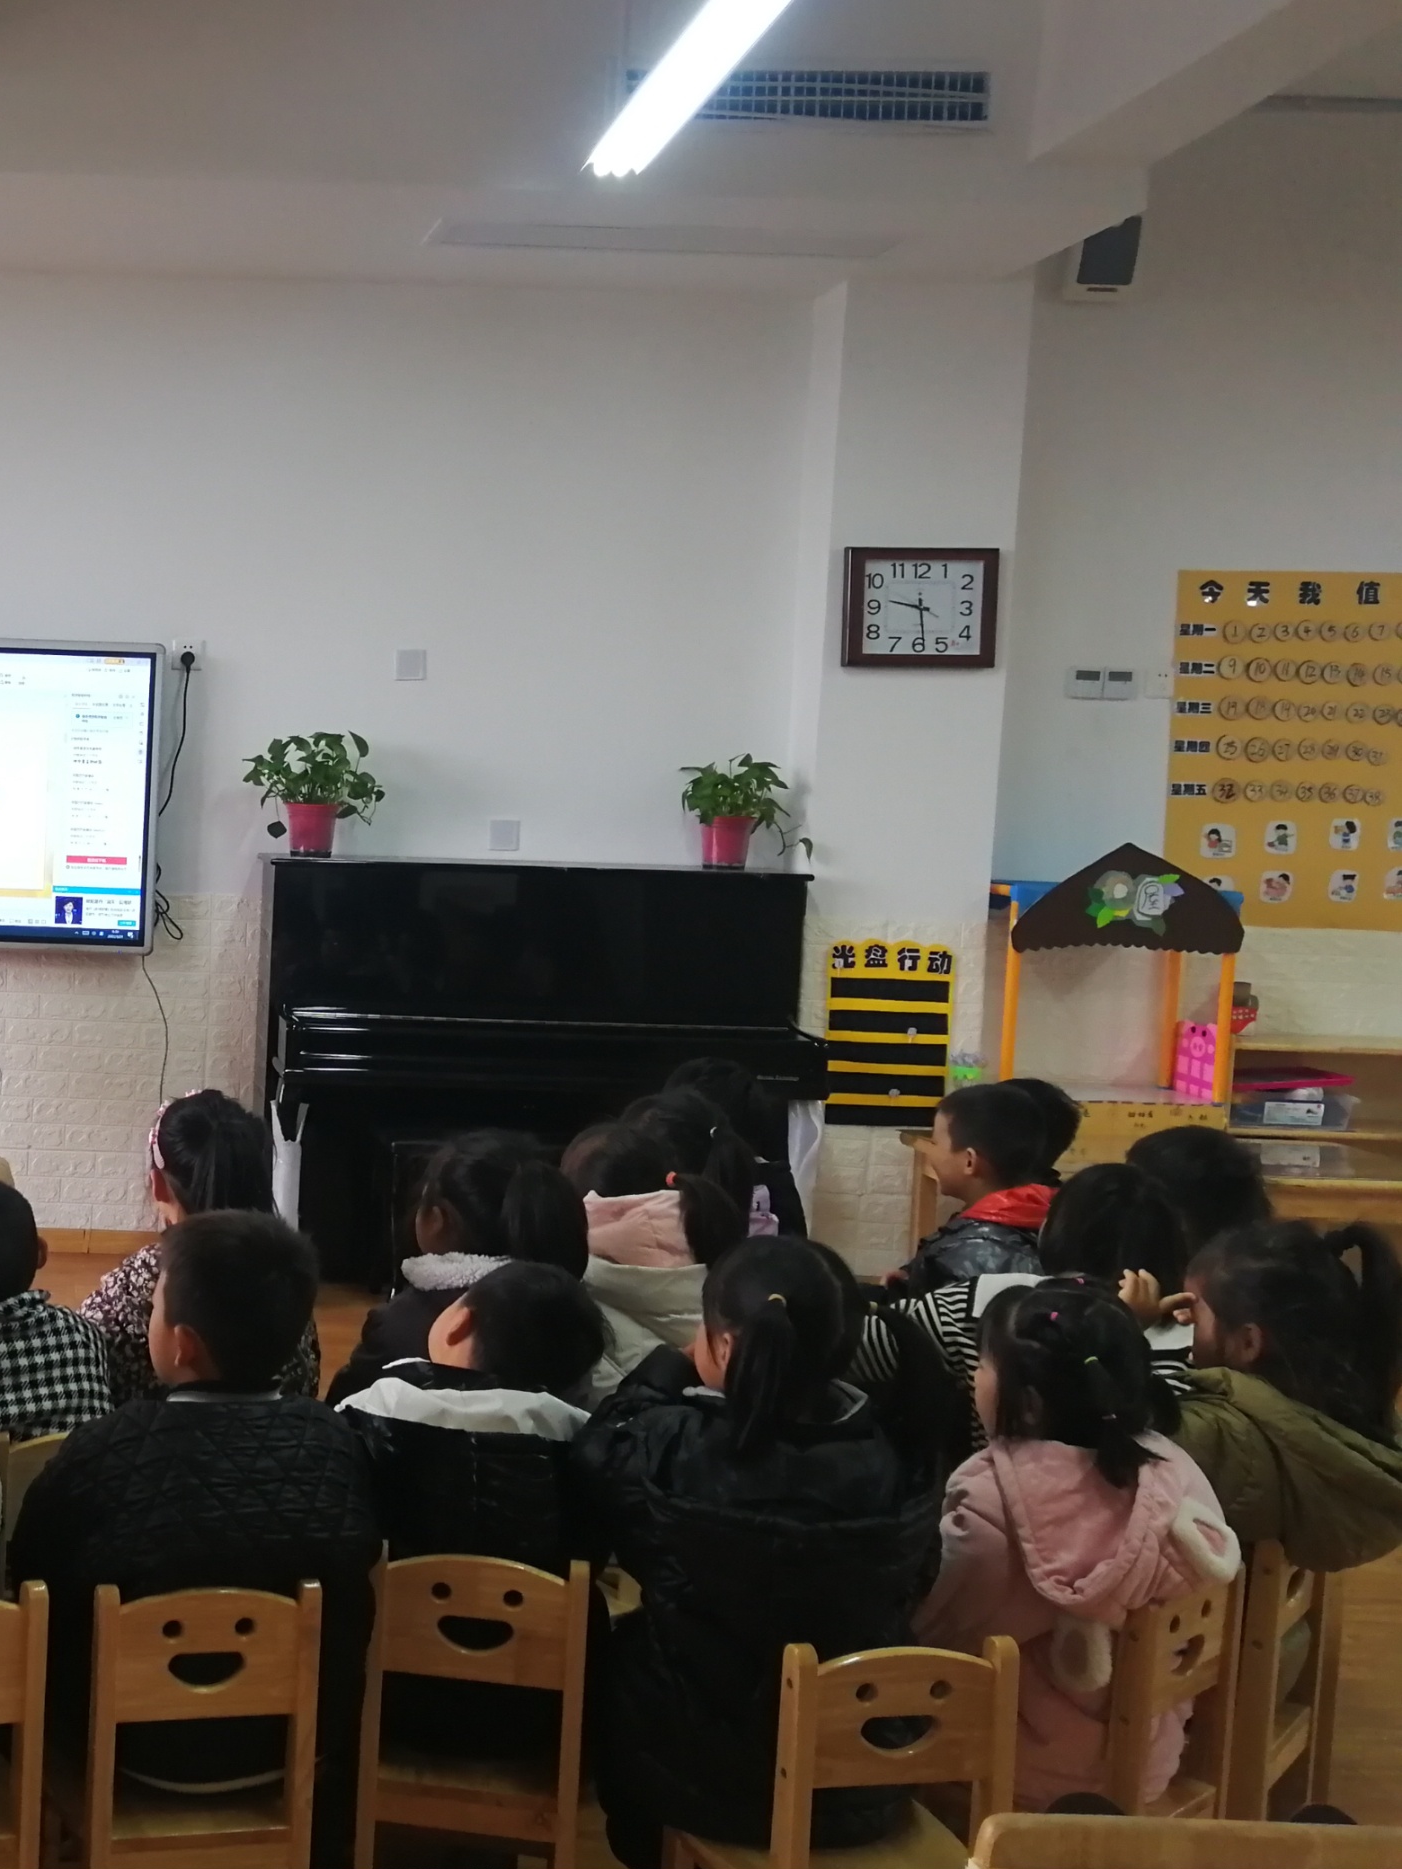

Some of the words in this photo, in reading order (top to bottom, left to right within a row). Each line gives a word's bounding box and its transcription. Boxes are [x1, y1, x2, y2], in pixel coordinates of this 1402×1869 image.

[890, 562, 905, 579] 11
[912, 562, 932, 579] 12
[941, 562, 948, 579] 1
[865, 573, 885, 589] 10
[960, 574, 975, 590] 2
[1199, 579, 1381, 605] 今天我值
[866, 599, 881, 615] 9
[959, 600, 974, 617] 3
[865, 623, 881, 640] 8
[958, 625, 972, 641] 4
[1179, 623, 1217, 636] 星期一
[888, 637, 902, 653] 7
[911, 637, 925, 653] 6
[935, 637, 949, 653] 5
[1179, 661, 1215, 675] 星期二
[1176, 701, 1213, 714] 星期三
[1173, 740, 1211, 753] 星期四
[1170, 783, 1207, 796] 星期五
[831, 944, 953, 975] 光盘行动
